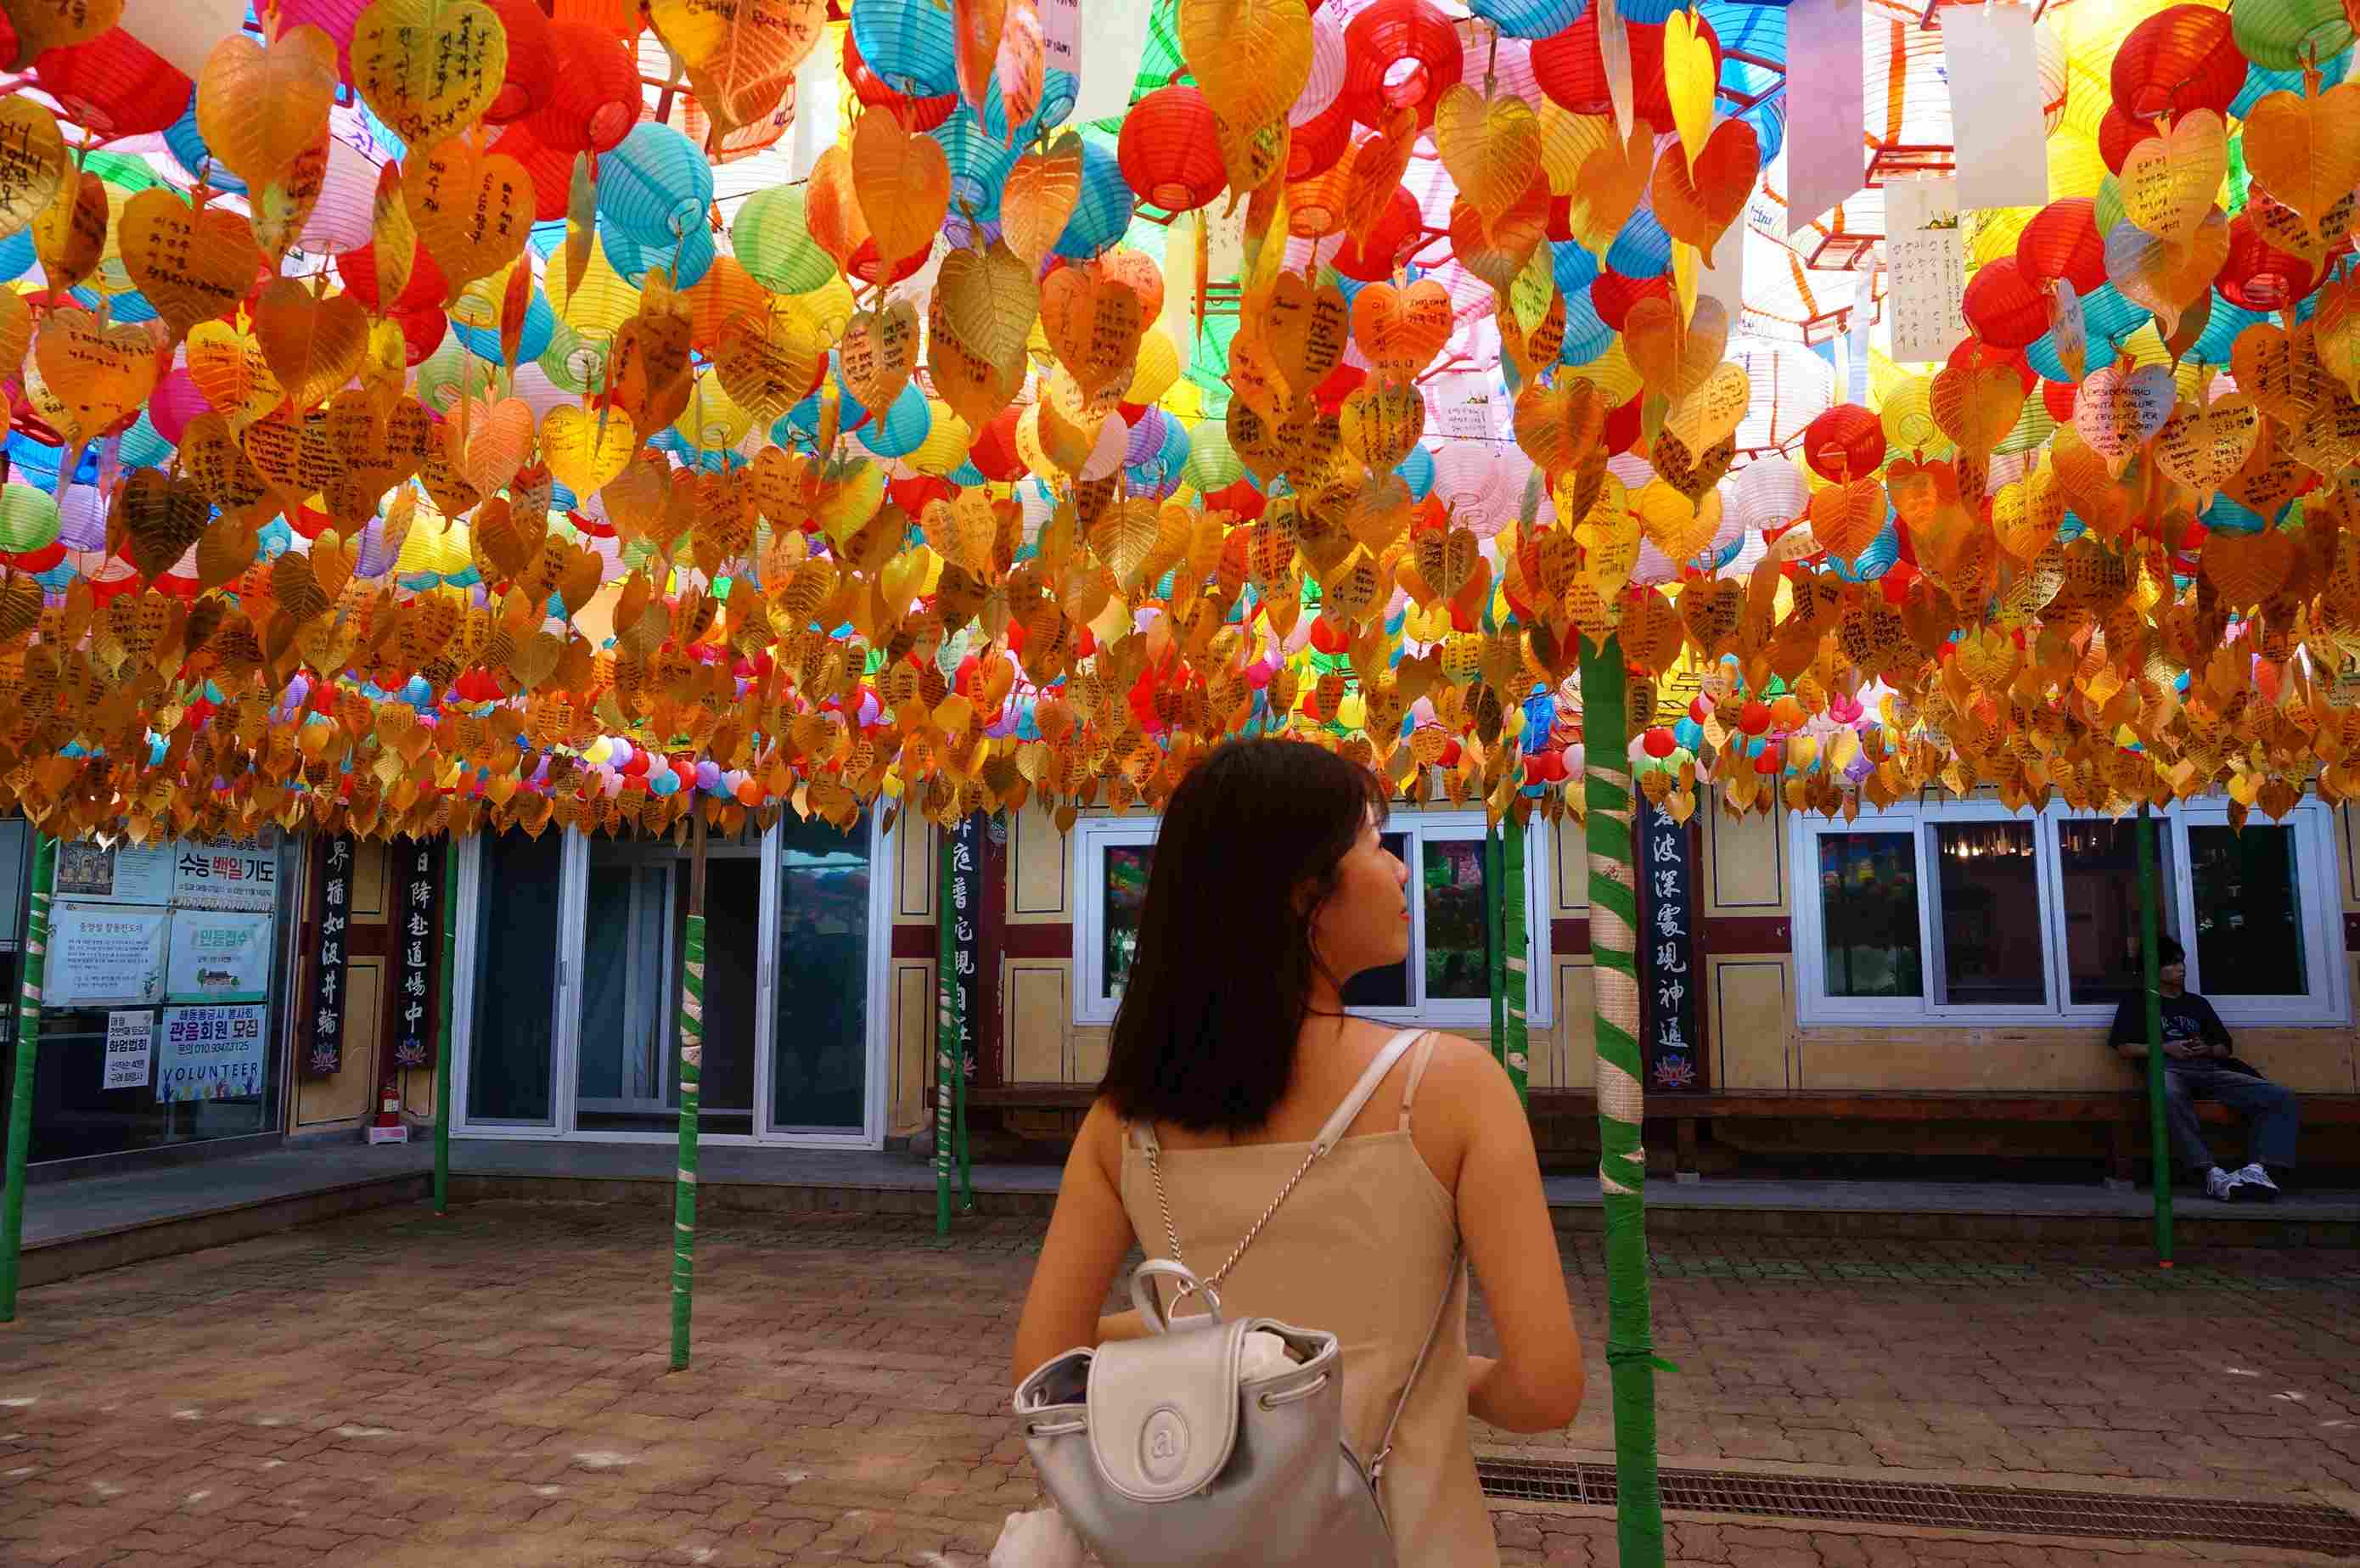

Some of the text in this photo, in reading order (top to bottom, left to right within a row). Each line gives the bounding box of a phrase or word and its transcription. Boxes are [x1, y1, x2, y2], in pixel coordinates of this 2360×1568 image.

[179, 852, 274, 882] 수능 백일 기도
[170, 1019, 259, 1043] 관음회원 모집
[108, 1038, 148, 1053] 화엄법회
[163, 1062, 258, 1082] VOLUNTEER
